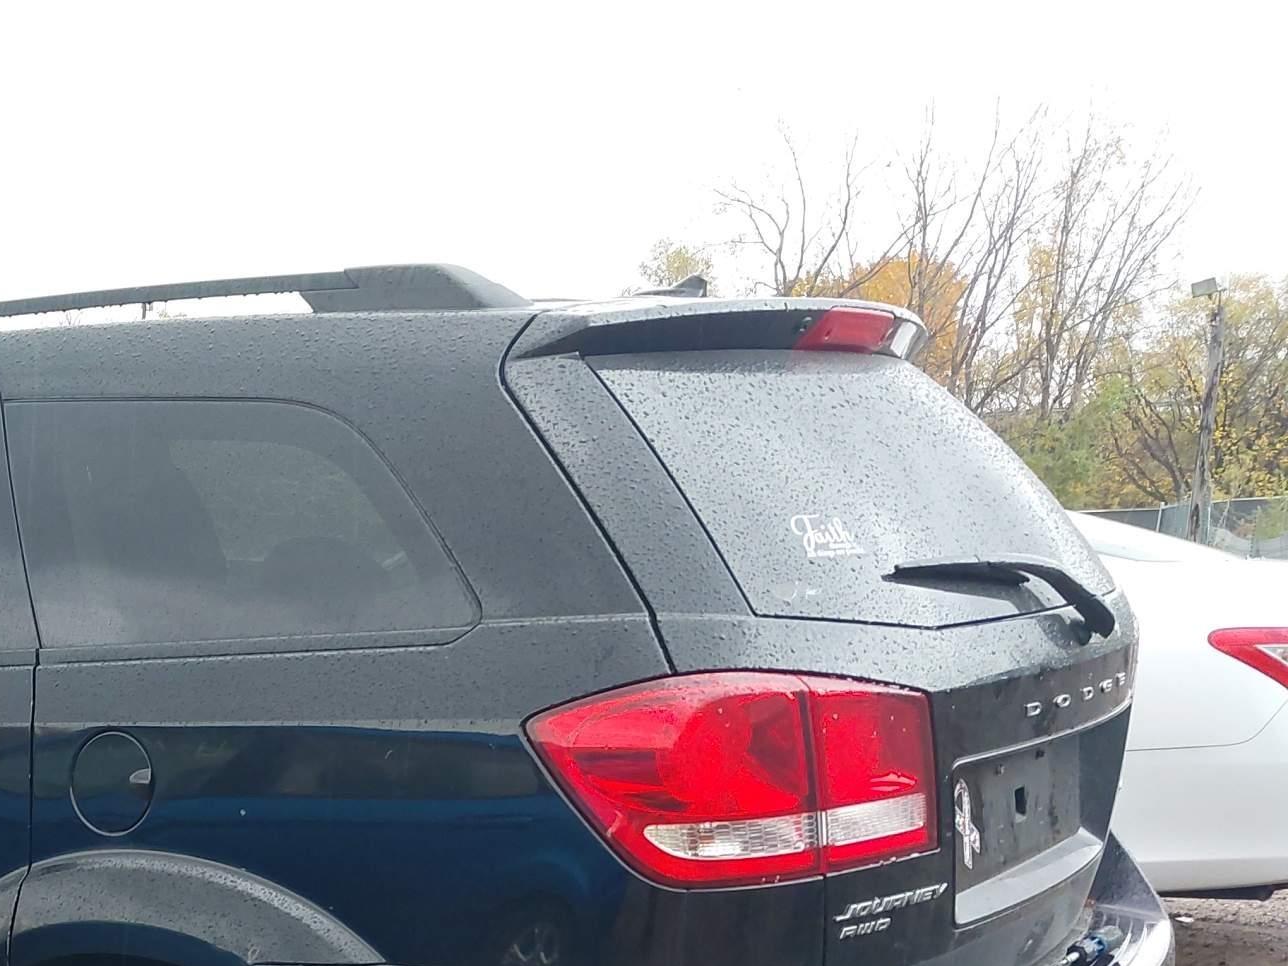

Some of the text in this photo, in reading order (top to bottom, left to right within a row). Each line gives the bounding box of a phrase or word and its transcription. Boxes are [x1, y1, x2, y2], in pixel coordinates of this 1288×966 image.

[790, 513, 855, 549] Faith
[1024, 671, 1127, 717] DODGE
[833, 882, 948, 921] JOURNEY
[839, 917, 891, 940] AWD
